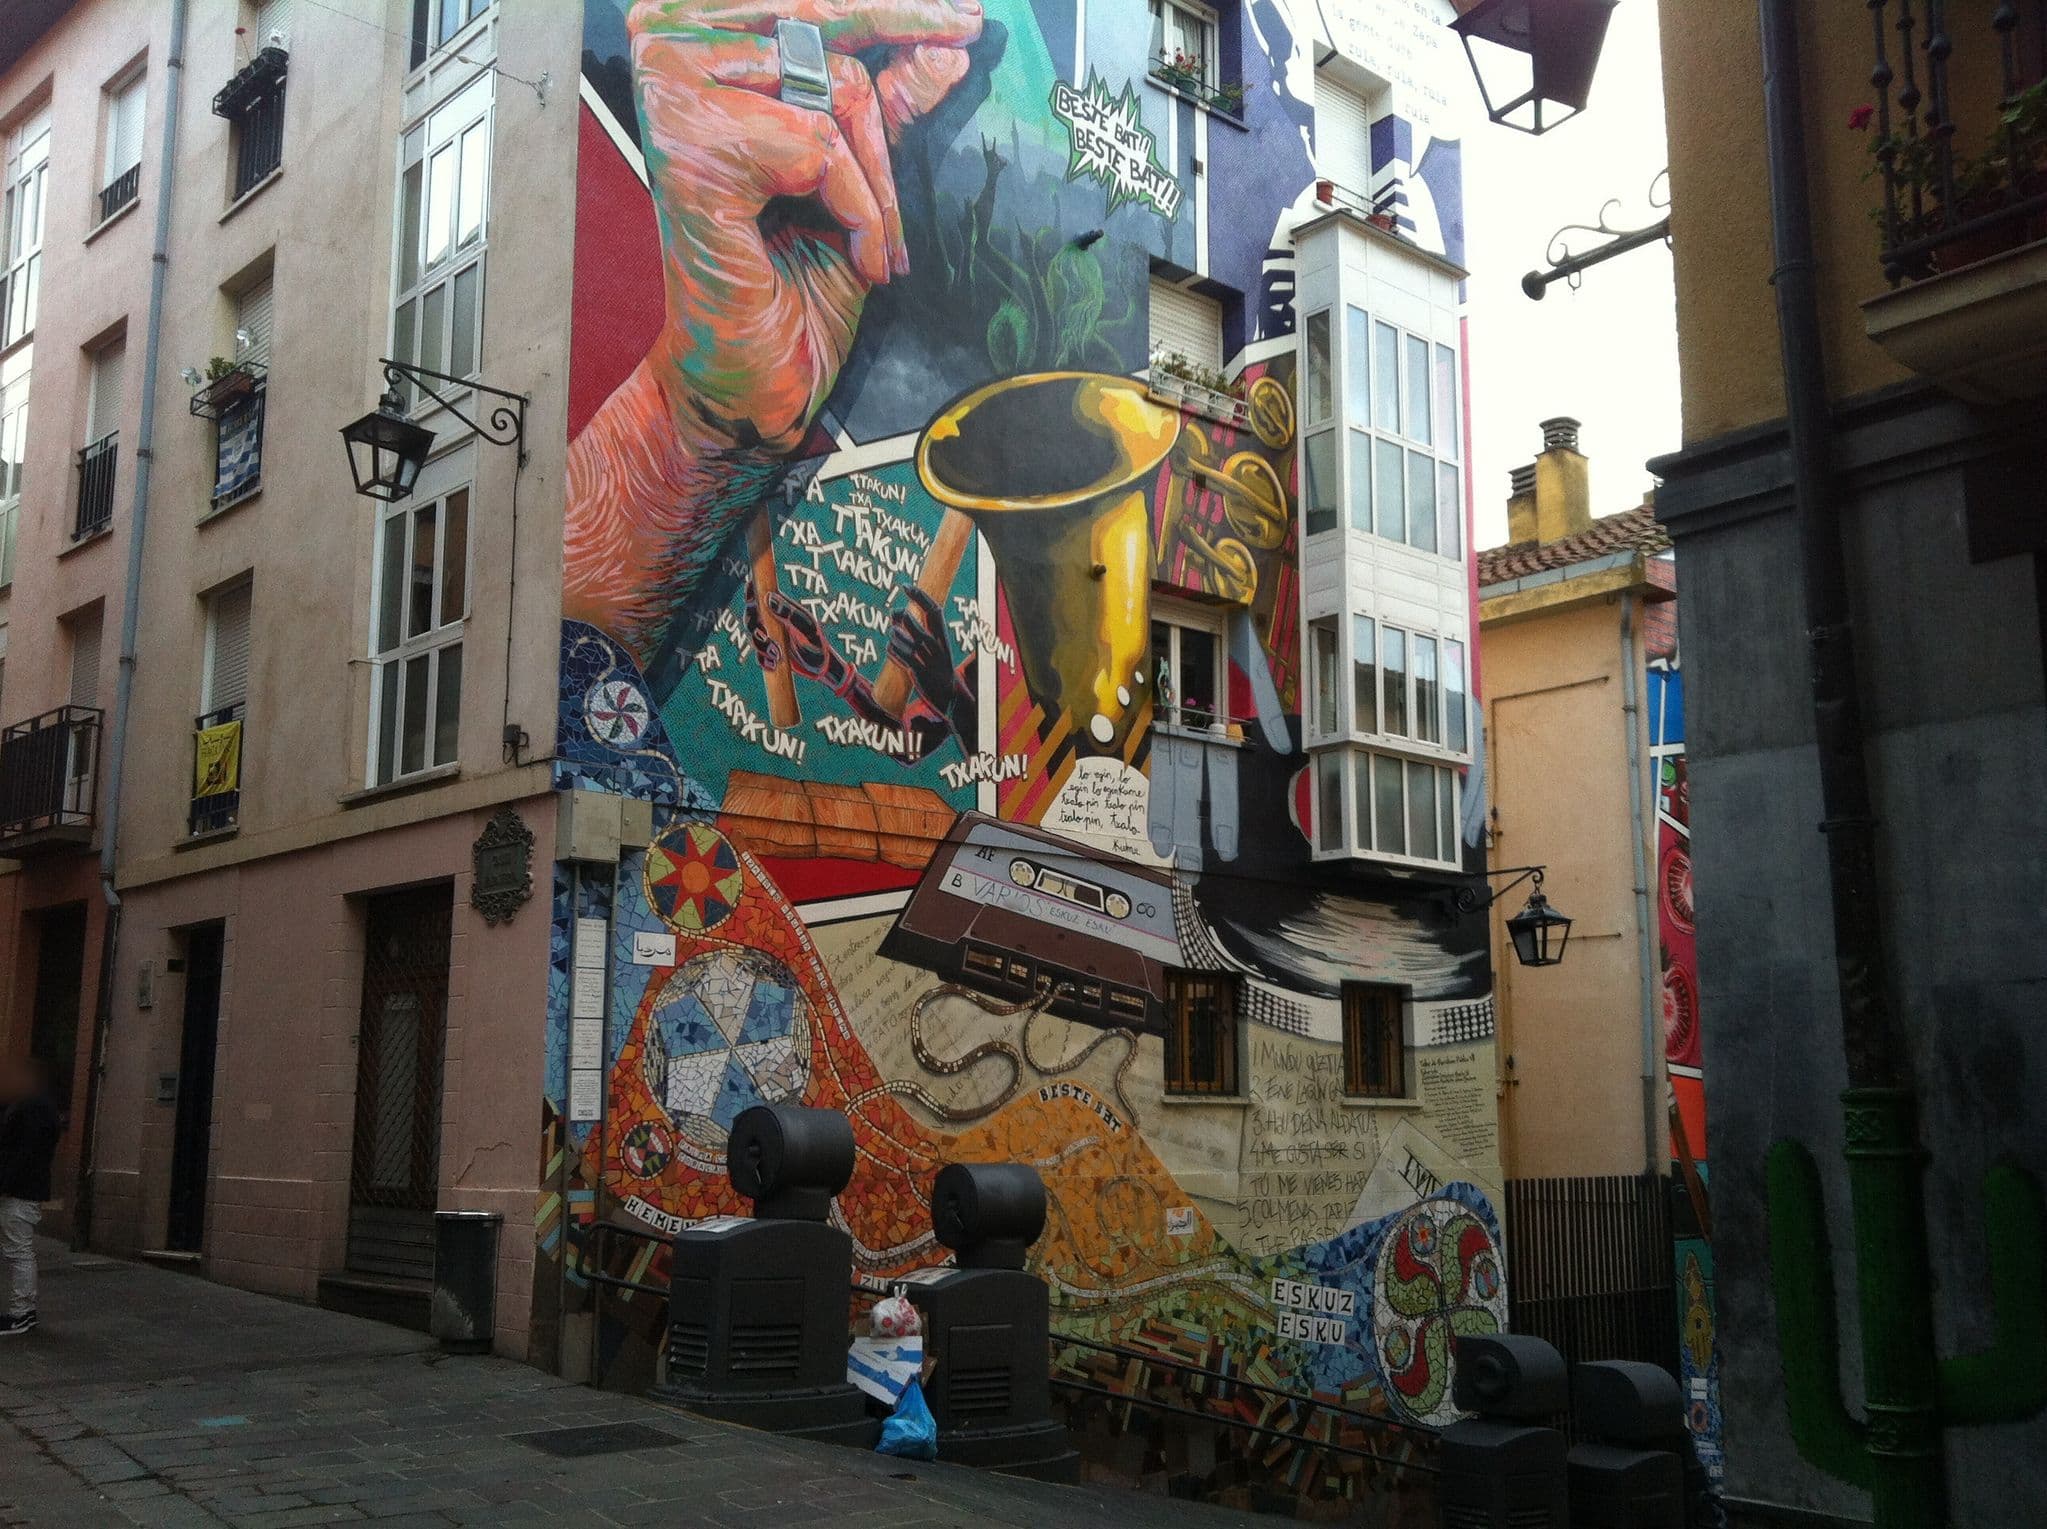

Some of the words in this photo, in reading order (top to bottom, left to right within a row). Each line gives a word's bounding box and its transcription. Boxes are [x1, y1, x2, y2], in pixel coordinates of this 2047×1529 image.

[1060, 90, 1109, 132] BESTE
[1115, 122, 1150, 154] BAT!!
[1075, 127, 1126, 176] BESTE
[849, 473, 906, 505] TTAKUN!
[849, 492, 872, 508] TXA
[784, 564, 829, 594] TTA
[801, 592, 890, 633] TXAKUN
[950, 620, 1015, 676] TXAKUN!
[707, 678, 806, 765] TXAKUN!
[816, 716, 922, 760] TXAKUN!!
[940, 752, 1028, 789] TXAKUN!
[952, 873, 962, 888] B
[1040, 1083, 1092, 1104] BESTE
[1274, 1282, 1353, 1312] ESKUZ
[1281, 1317, 1343, 1341] ESKU
